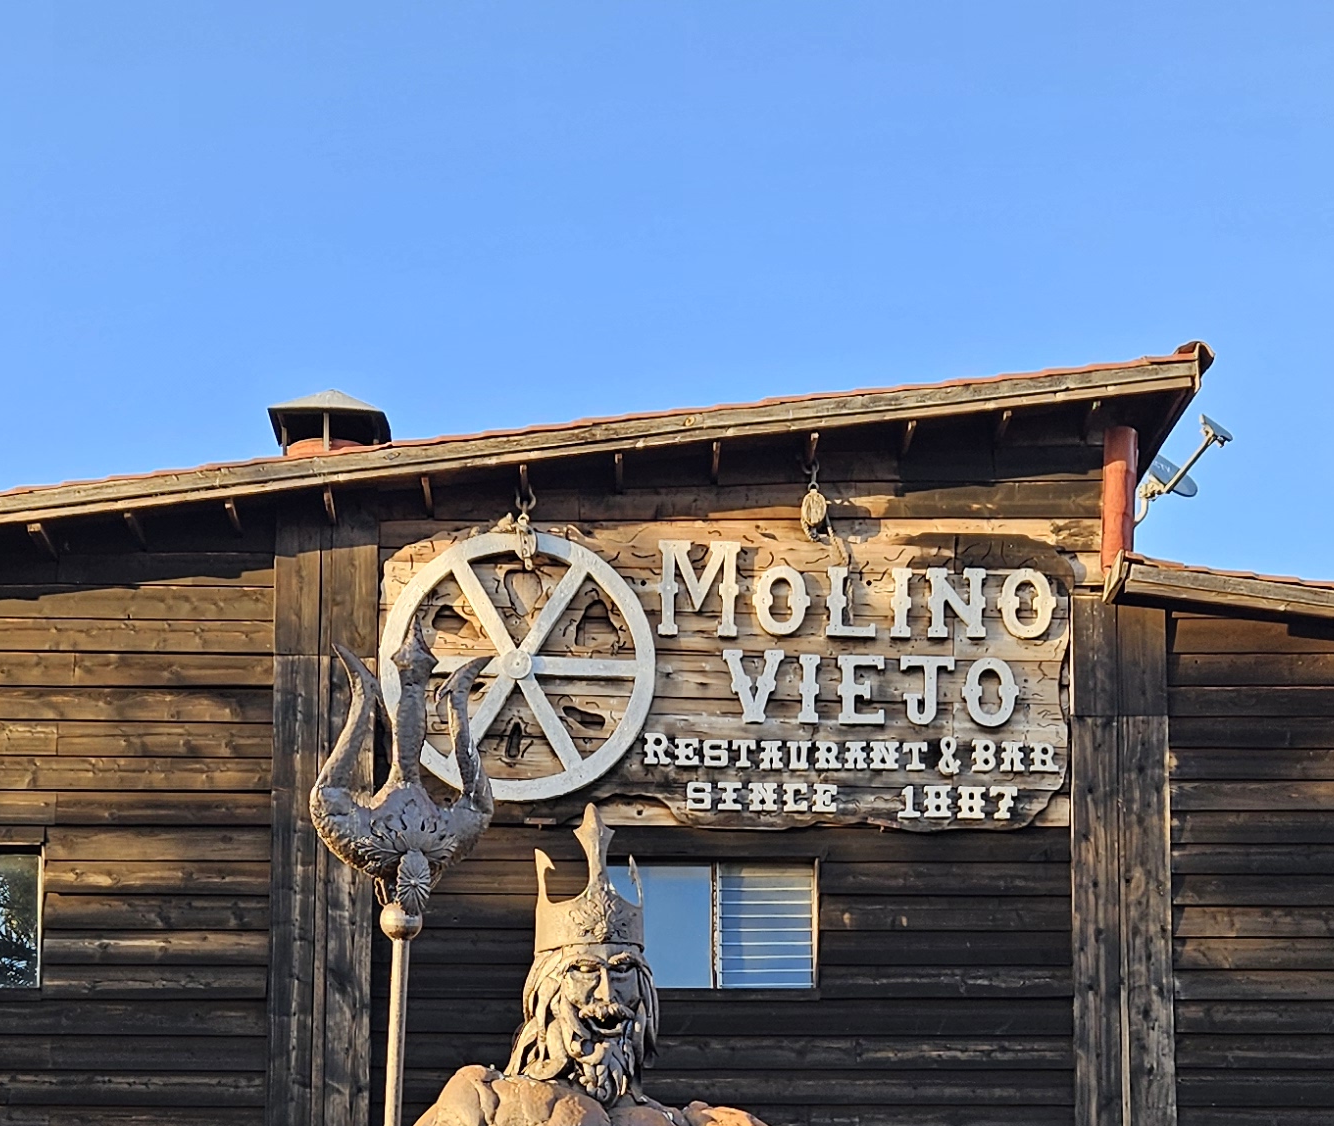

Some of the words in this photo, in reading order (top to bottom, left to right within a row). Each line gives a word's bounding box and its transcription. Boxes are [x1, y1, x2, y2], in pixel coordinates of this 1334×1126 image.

[657, 540, 1057, 640] MOLINO
[723, 649, 1019, 728] VIEJO
[644, 733, 928, 771] RESTAURANT
[938, 736, 961, 776] &
[971, 739, 1060, 773] BAR
[685, 782, 838, 813] SINCE
[896, 785, 1018, 820] 1887
